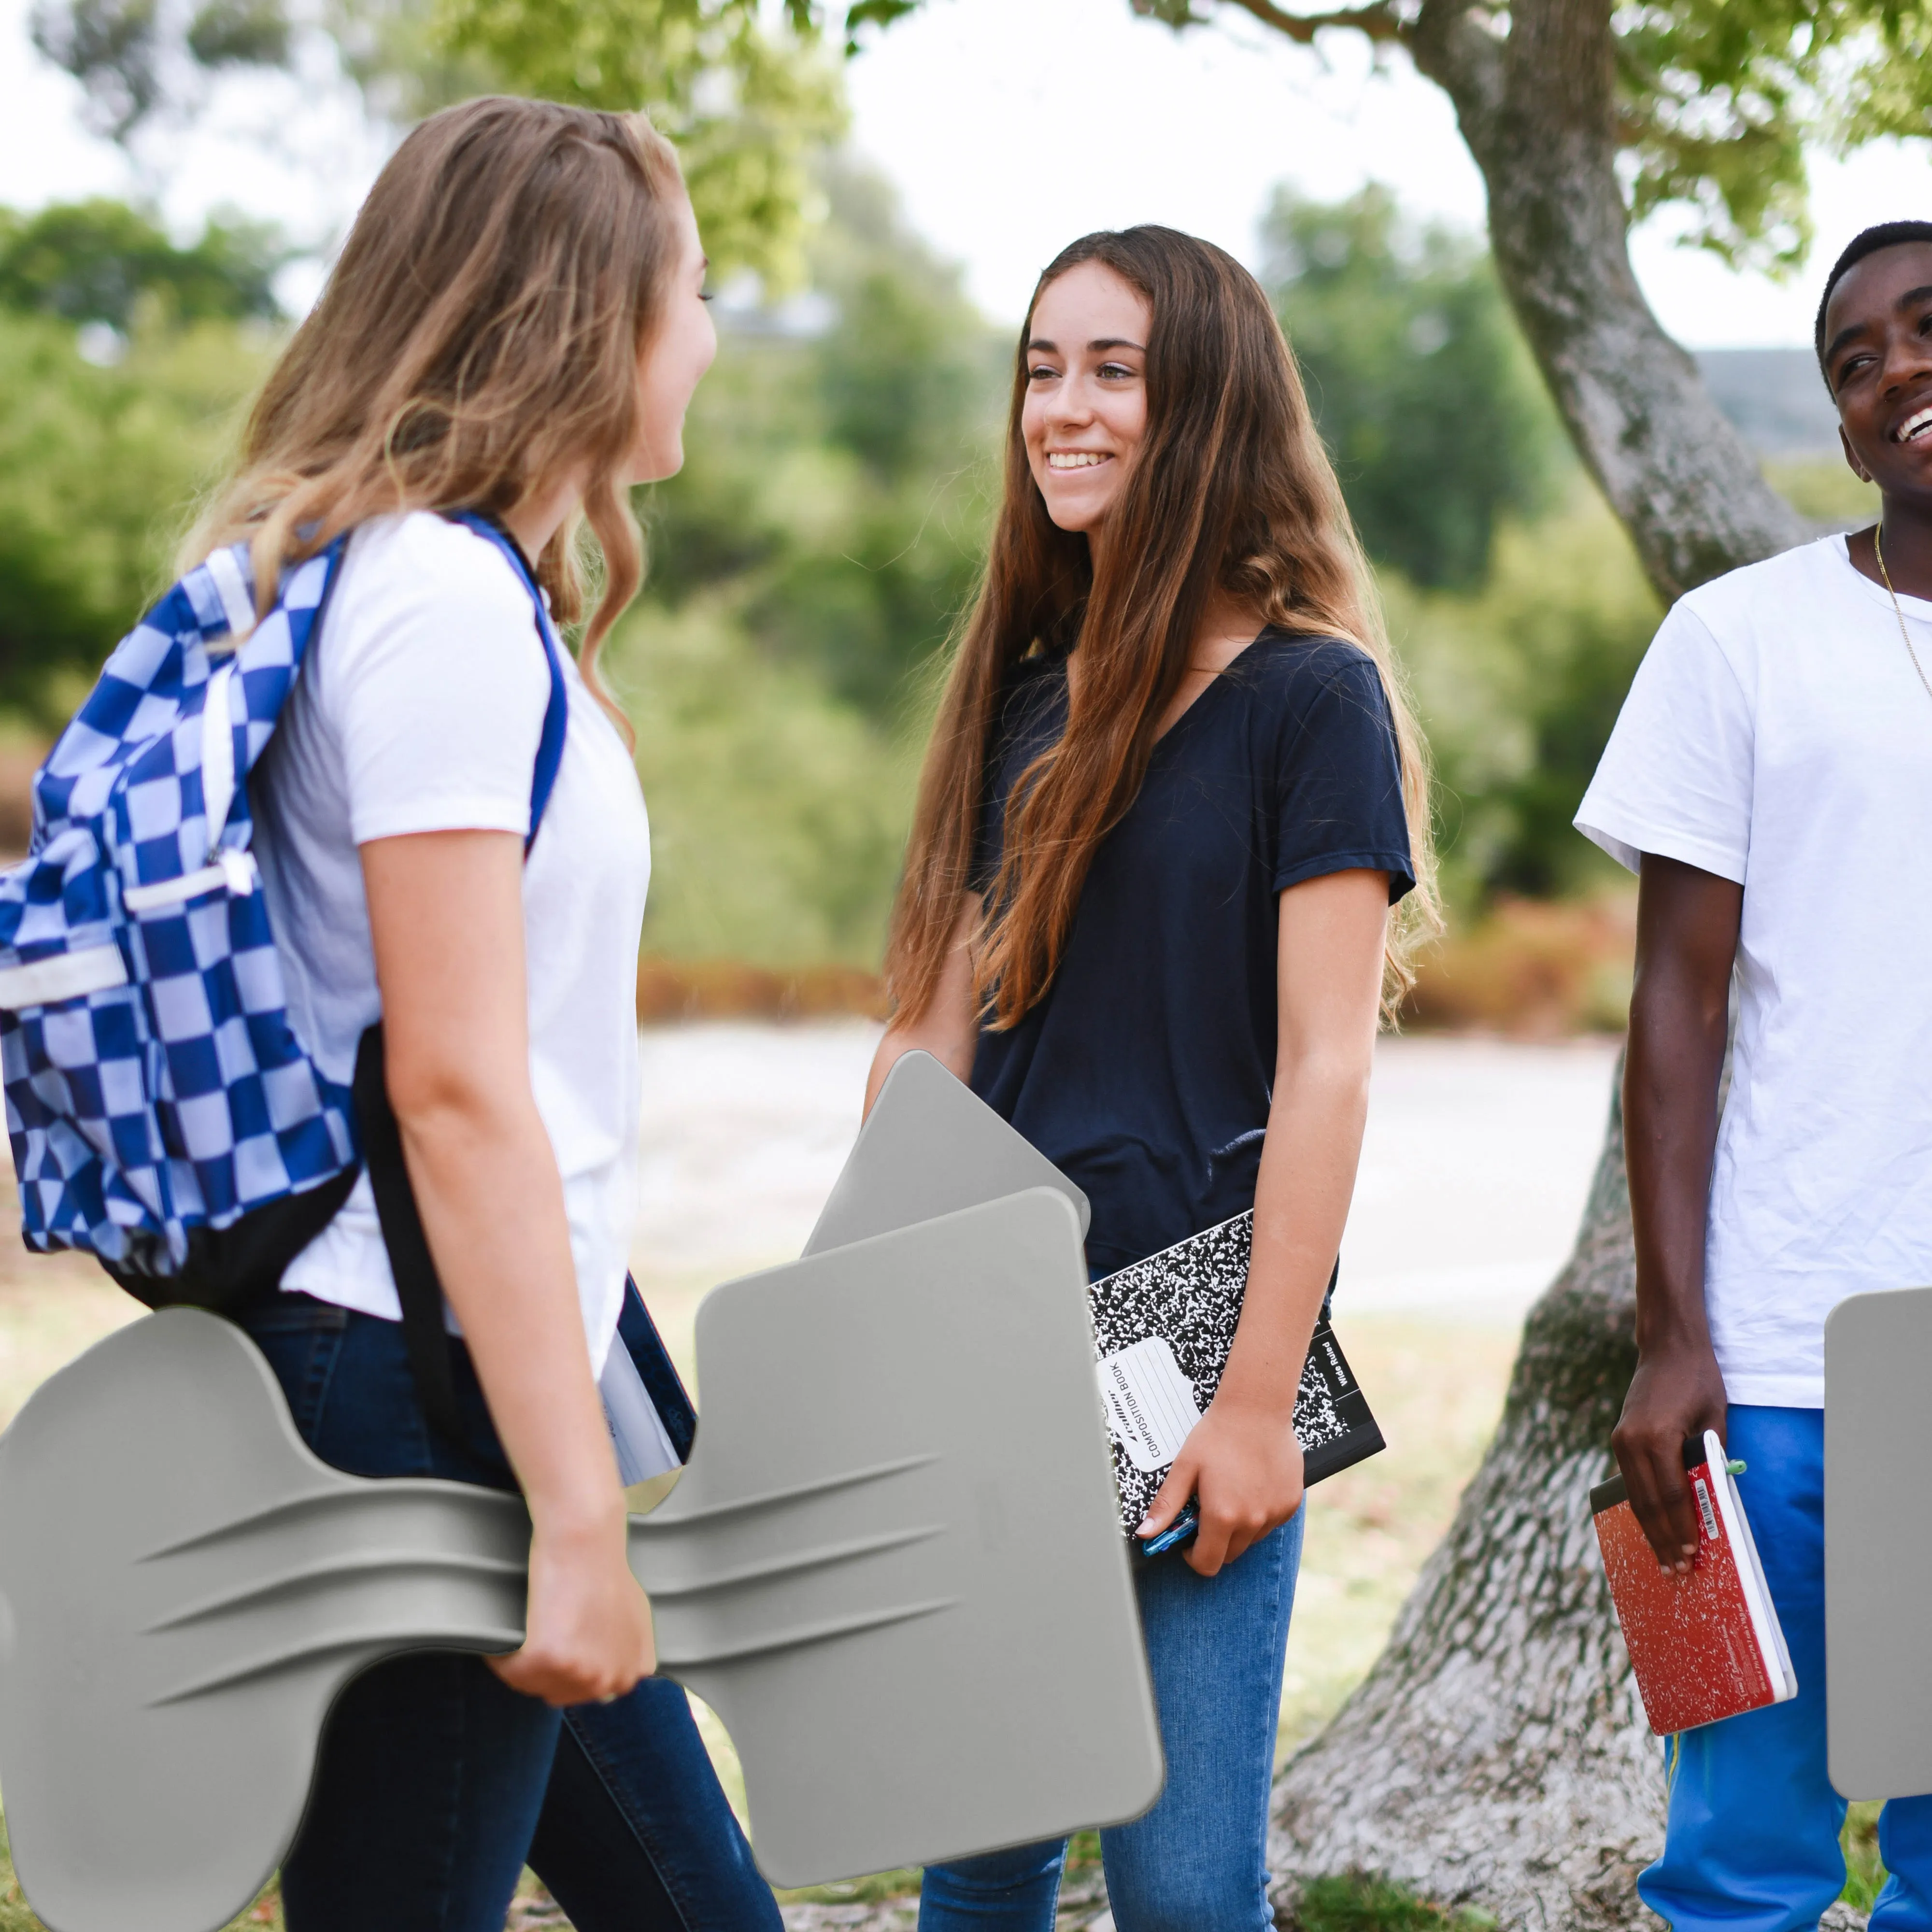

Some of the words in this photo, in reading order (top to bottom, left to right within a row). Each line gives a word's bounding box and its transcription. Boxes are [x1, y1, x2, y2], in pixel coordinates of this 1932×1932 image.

[1322, 1341, 1338, 1366] Ruled
[1109, 1362, 1129, 1391] BOOK
[1335, 1365, 1348, 1386] Wide
[1108, 1390, 1133, 1433] caliber
[1123, 1392, 1161, 1458] COMPOSITION
